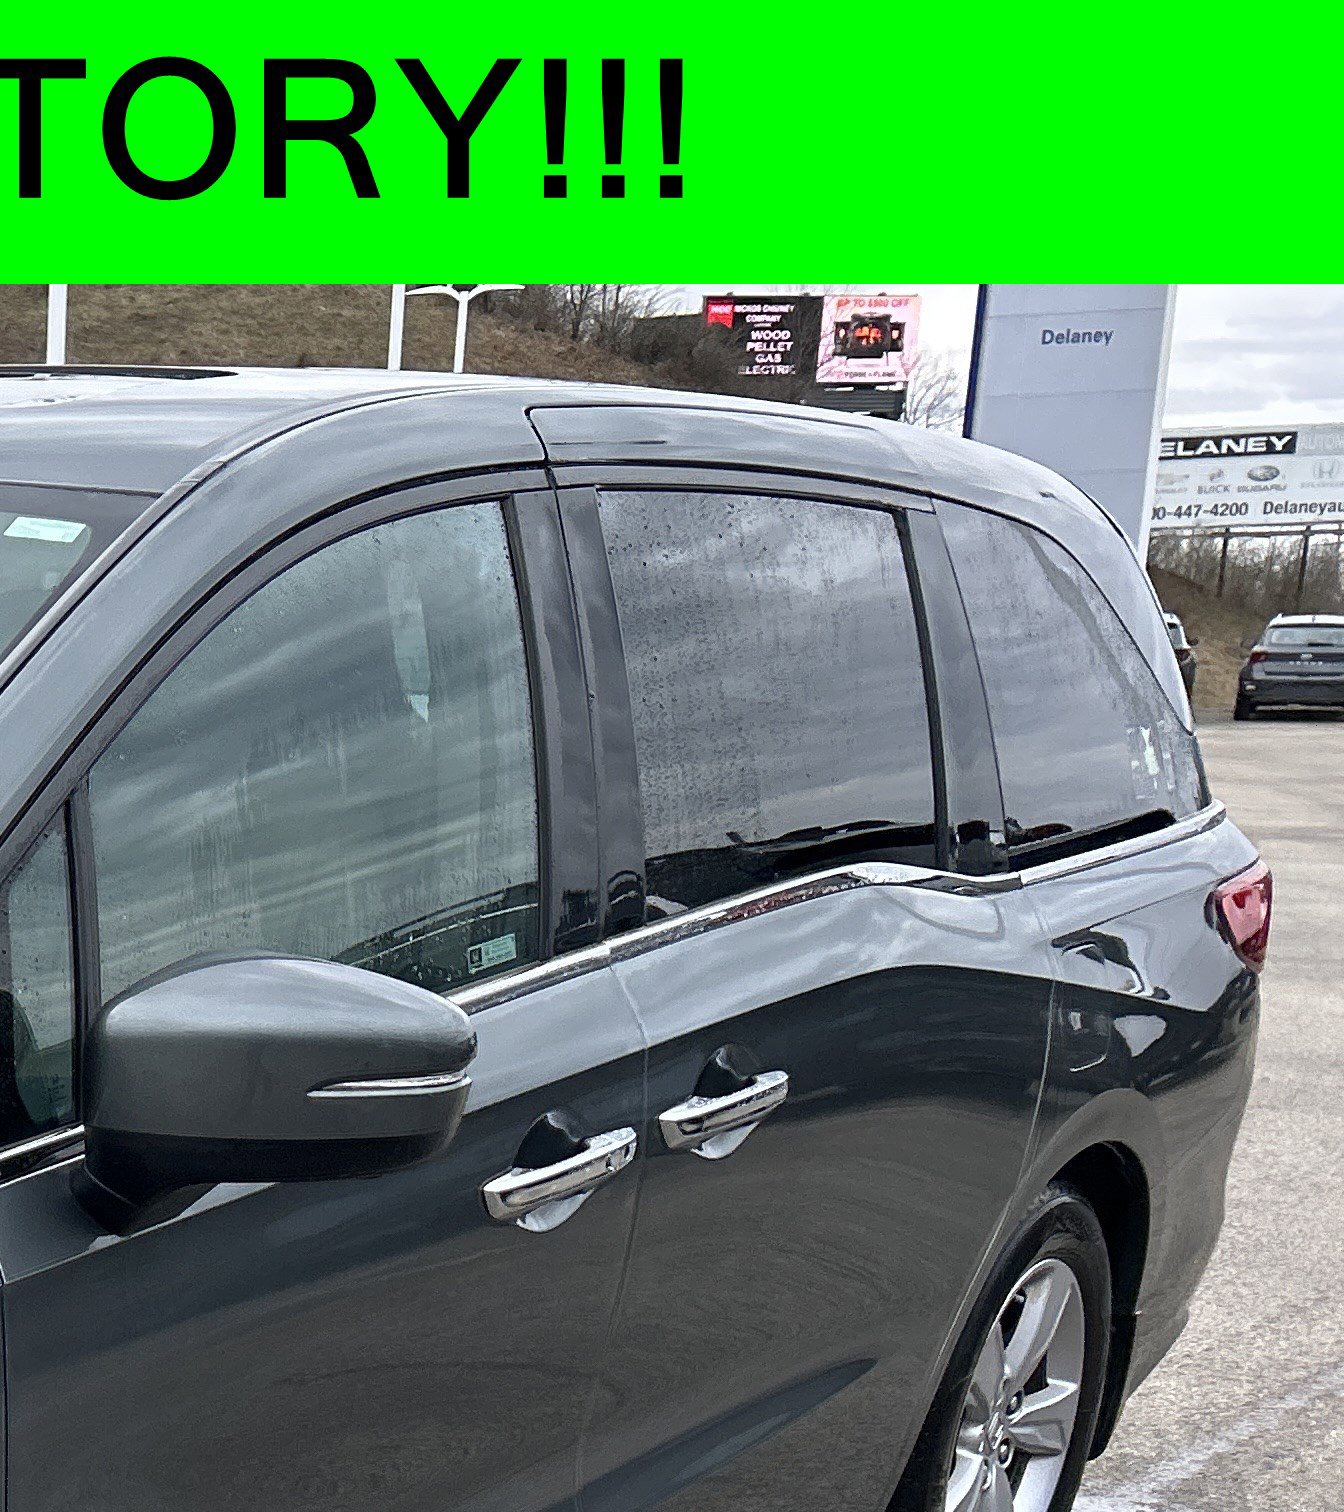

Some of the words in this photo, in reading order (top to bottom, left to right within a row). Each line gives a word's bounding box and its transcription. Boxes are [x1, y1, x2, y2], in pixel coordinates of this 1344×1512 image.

[751, 330, 791, 340] WOOD
[1041, 328, 1115, 346] Delaney
[746, 341, 794, 352] PELLET
[755, 353, 782, 363] GAS
